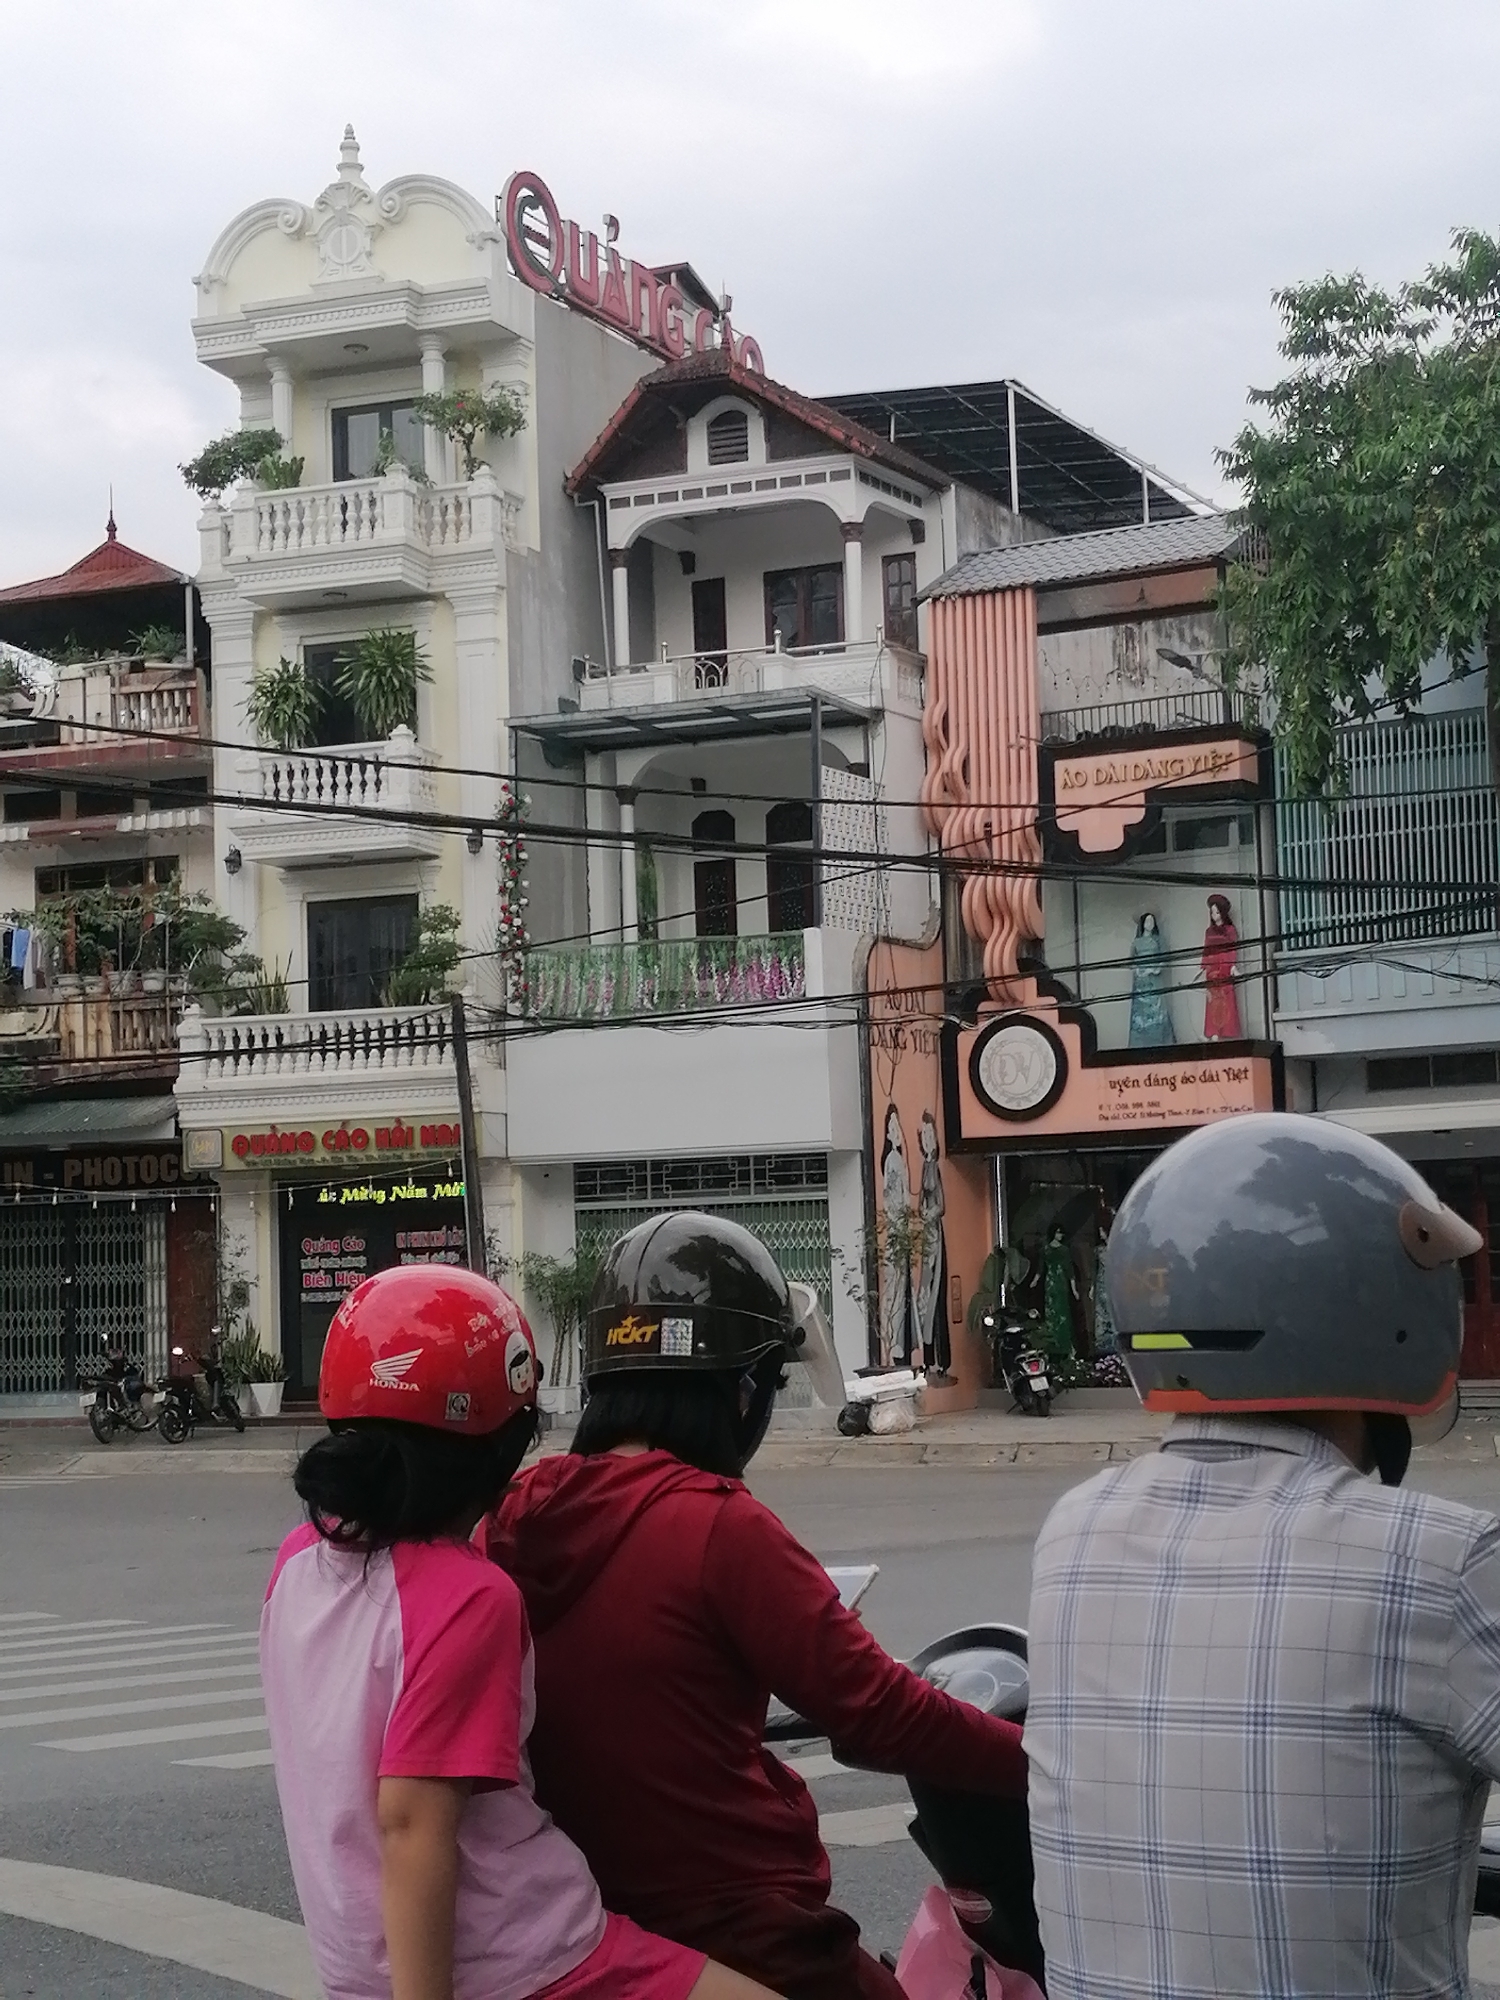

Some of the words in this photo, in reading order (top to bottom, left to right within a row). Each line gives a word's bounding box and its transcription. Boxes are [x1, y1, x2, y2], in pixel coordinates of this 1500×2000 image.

[499, 171, 684, 360] QUẢNG
[1061, 766, 1087, 790] ÁO
[1093, 762, 1127, 786] DÀI
[1131, 755, 1183, 781] DÁNG
[1180, 1071, 1196, 1084] áo
[232, 1123, 316, 1158] QUẢNG
[322, 1120, 370, 1151] CÁO
[375, 1117, 414, 1149] HẢI
[4, 1161, 34, 1189] IN
[302, 1235, 340, 1255] Quảng
[342, 1236, 366, 1252] Cáo
[302, 1270, 333, 1288] Biển
[369, 1378, 421, 1392] HONDA
